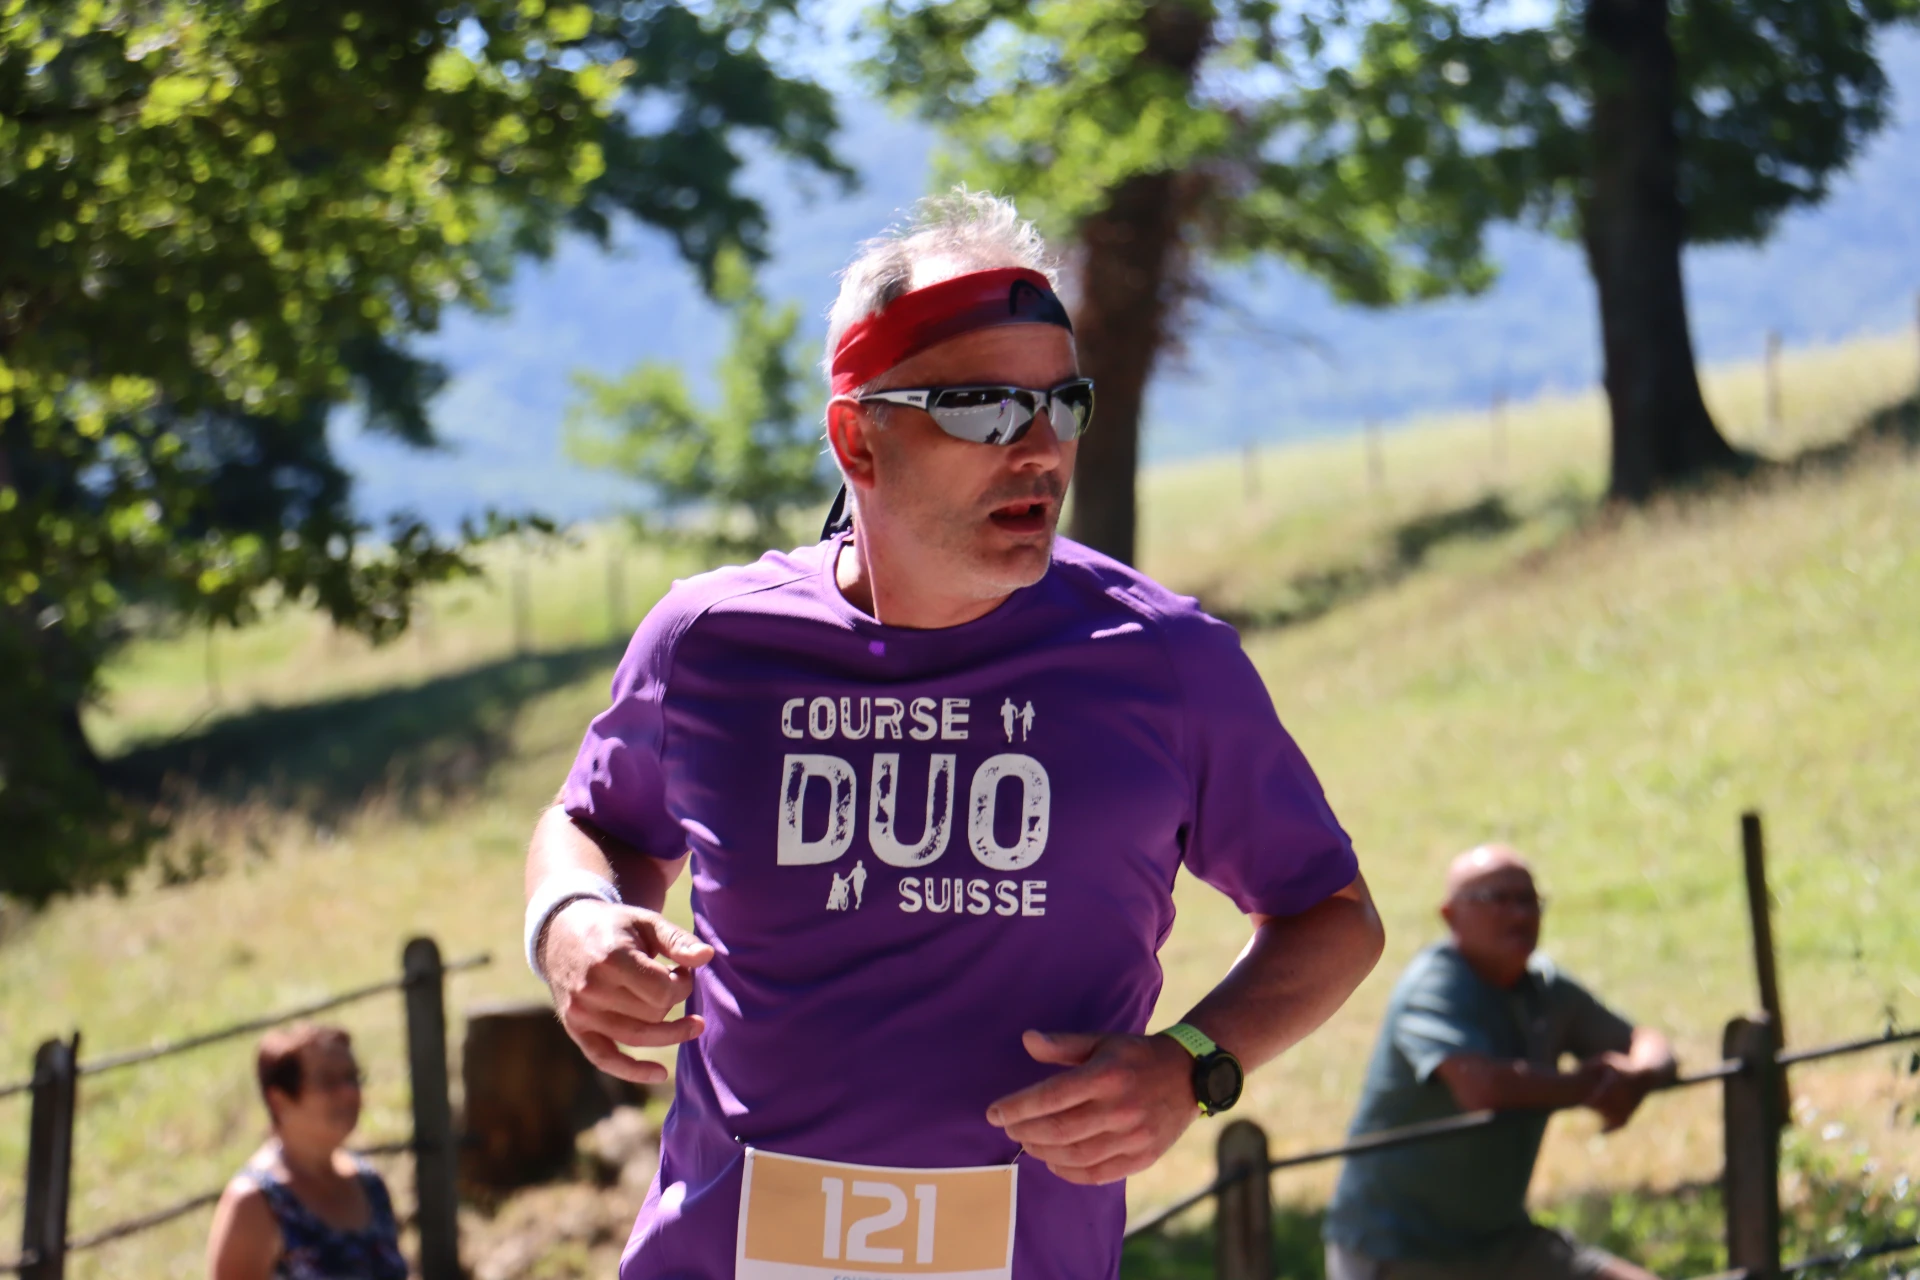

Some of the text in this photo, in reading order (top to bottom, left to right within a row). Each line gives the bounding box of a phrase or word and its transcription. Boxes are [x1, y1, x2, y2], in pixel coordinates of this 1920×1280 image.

[781, 696, 970, 741] COURSE
[777, 753, 1051, 871] DUO
[898, 876, 1047, 916] SUISSE
[821, 1177, 937, 1264] 121
